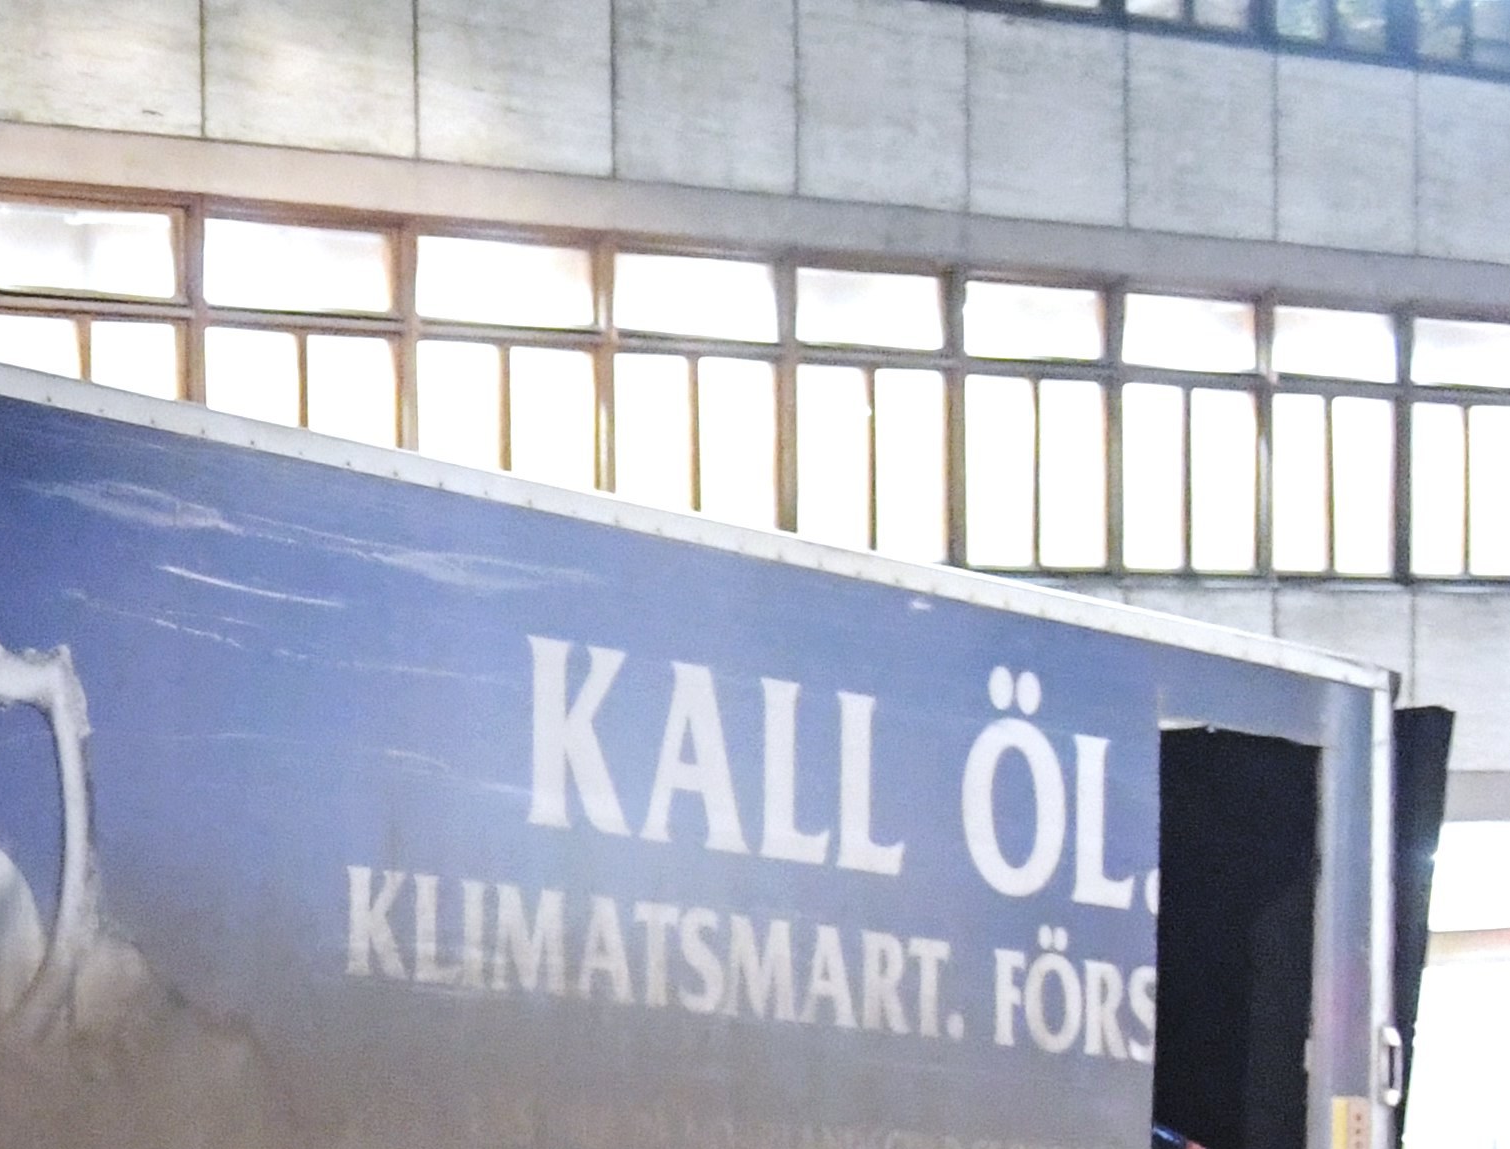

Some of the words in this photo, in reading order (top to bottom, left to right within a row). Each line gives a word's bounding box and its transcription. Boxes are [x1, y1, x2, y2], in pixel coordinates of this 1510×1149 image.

[526, 633, 906, 877] KALL
[345, 864, 965, 1042] KLIMATSMART.
[993, 923, 1157, 1066] FÖRS
